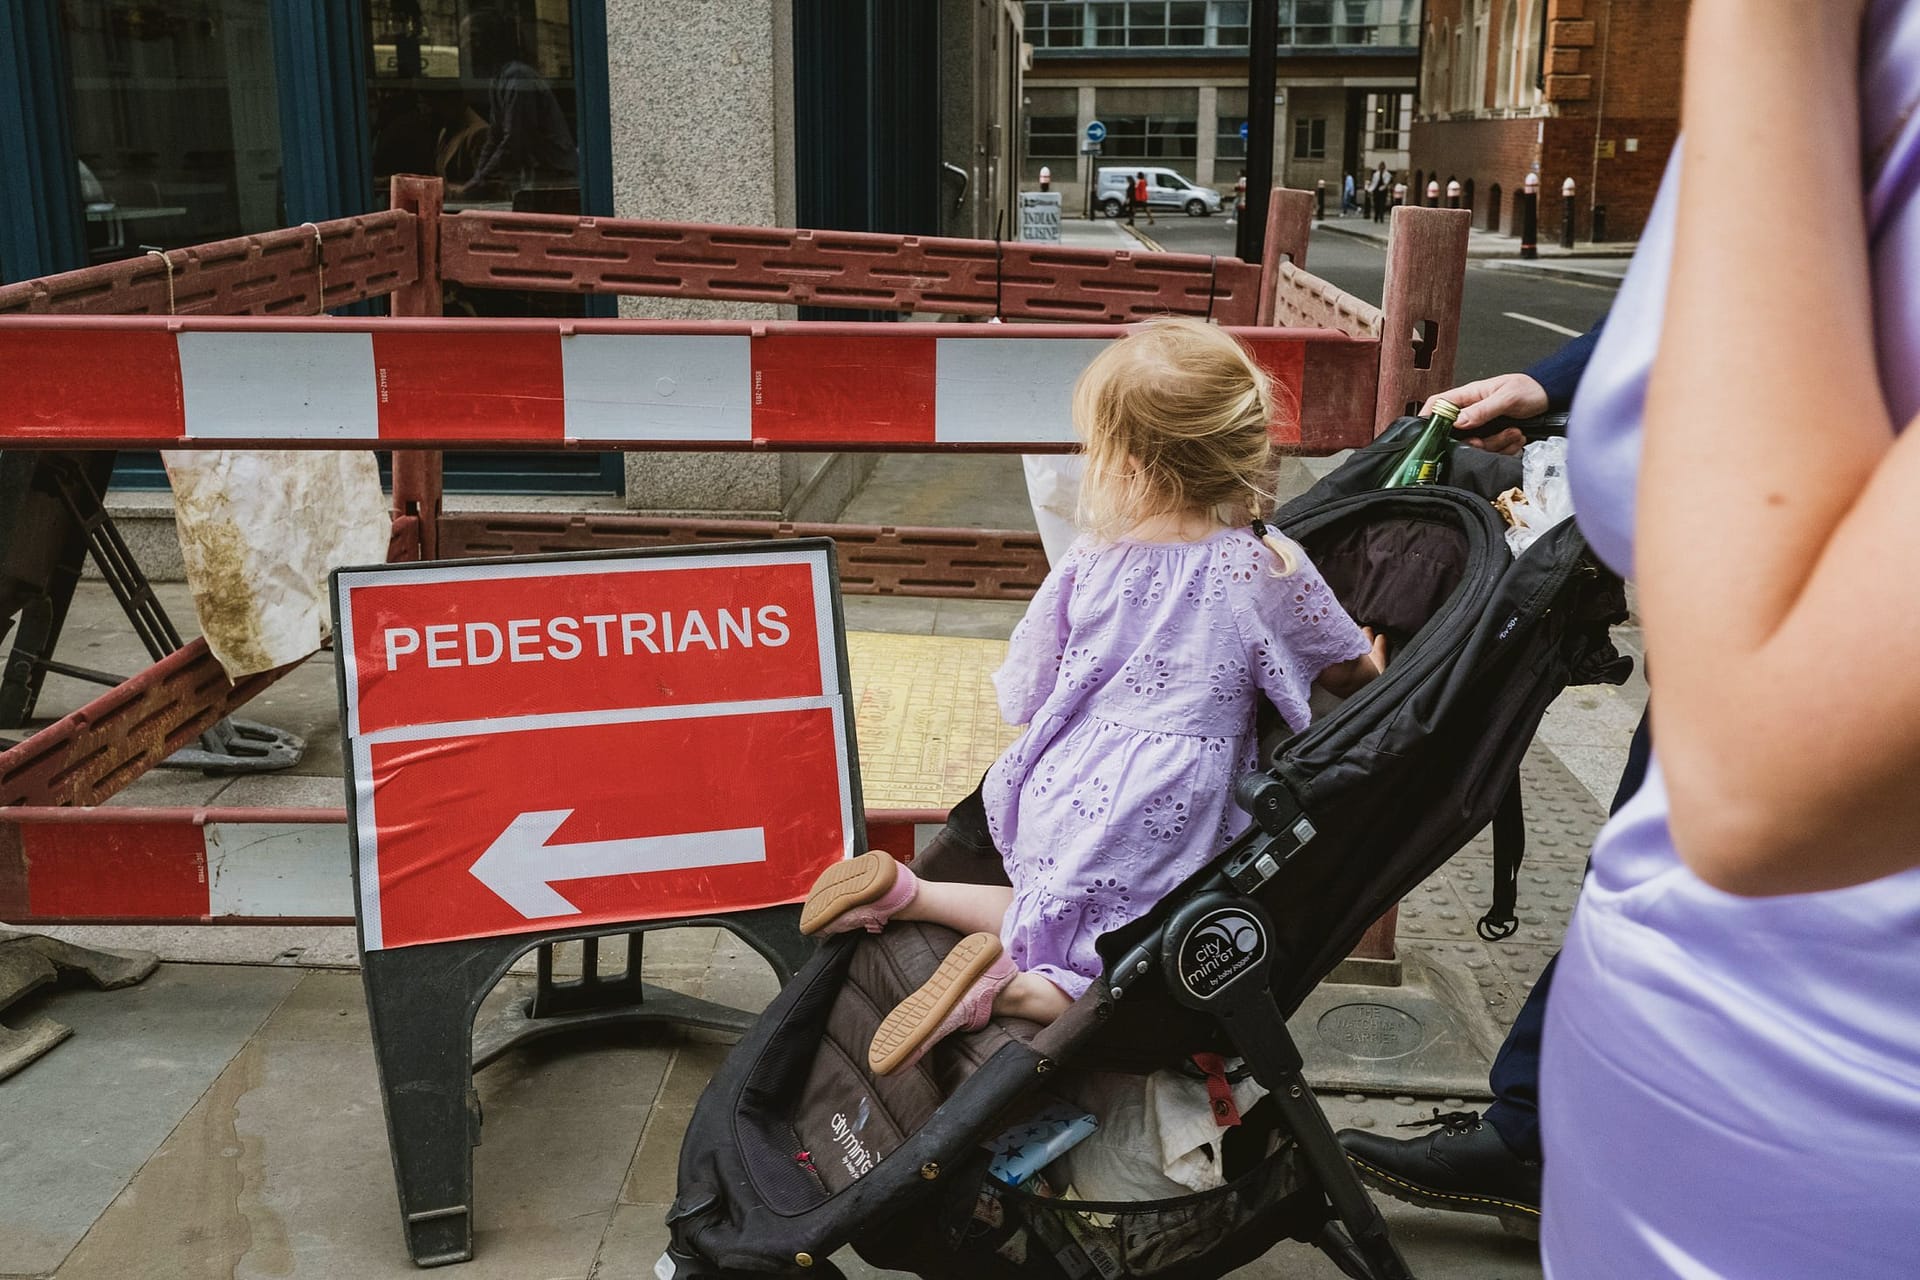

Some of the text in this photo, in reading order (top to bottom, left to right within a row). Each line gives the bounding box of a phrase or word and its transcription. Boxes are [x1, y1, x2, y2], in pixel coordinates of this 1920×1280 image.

[1023, 212, 1058, 225] INDIAN
[383, 604, 792, 672] PEDESTRIANS
[1195, 938, 1221, 963] city
[1187, 948, 1234, 986] mini GT
[1356, 1006, 1382, 1019] THE
[1344, 1032, 1399, 1045] BARRIER
[831, 1112, 851, 1142] city
[841, 1133, 869, 1167] mini
